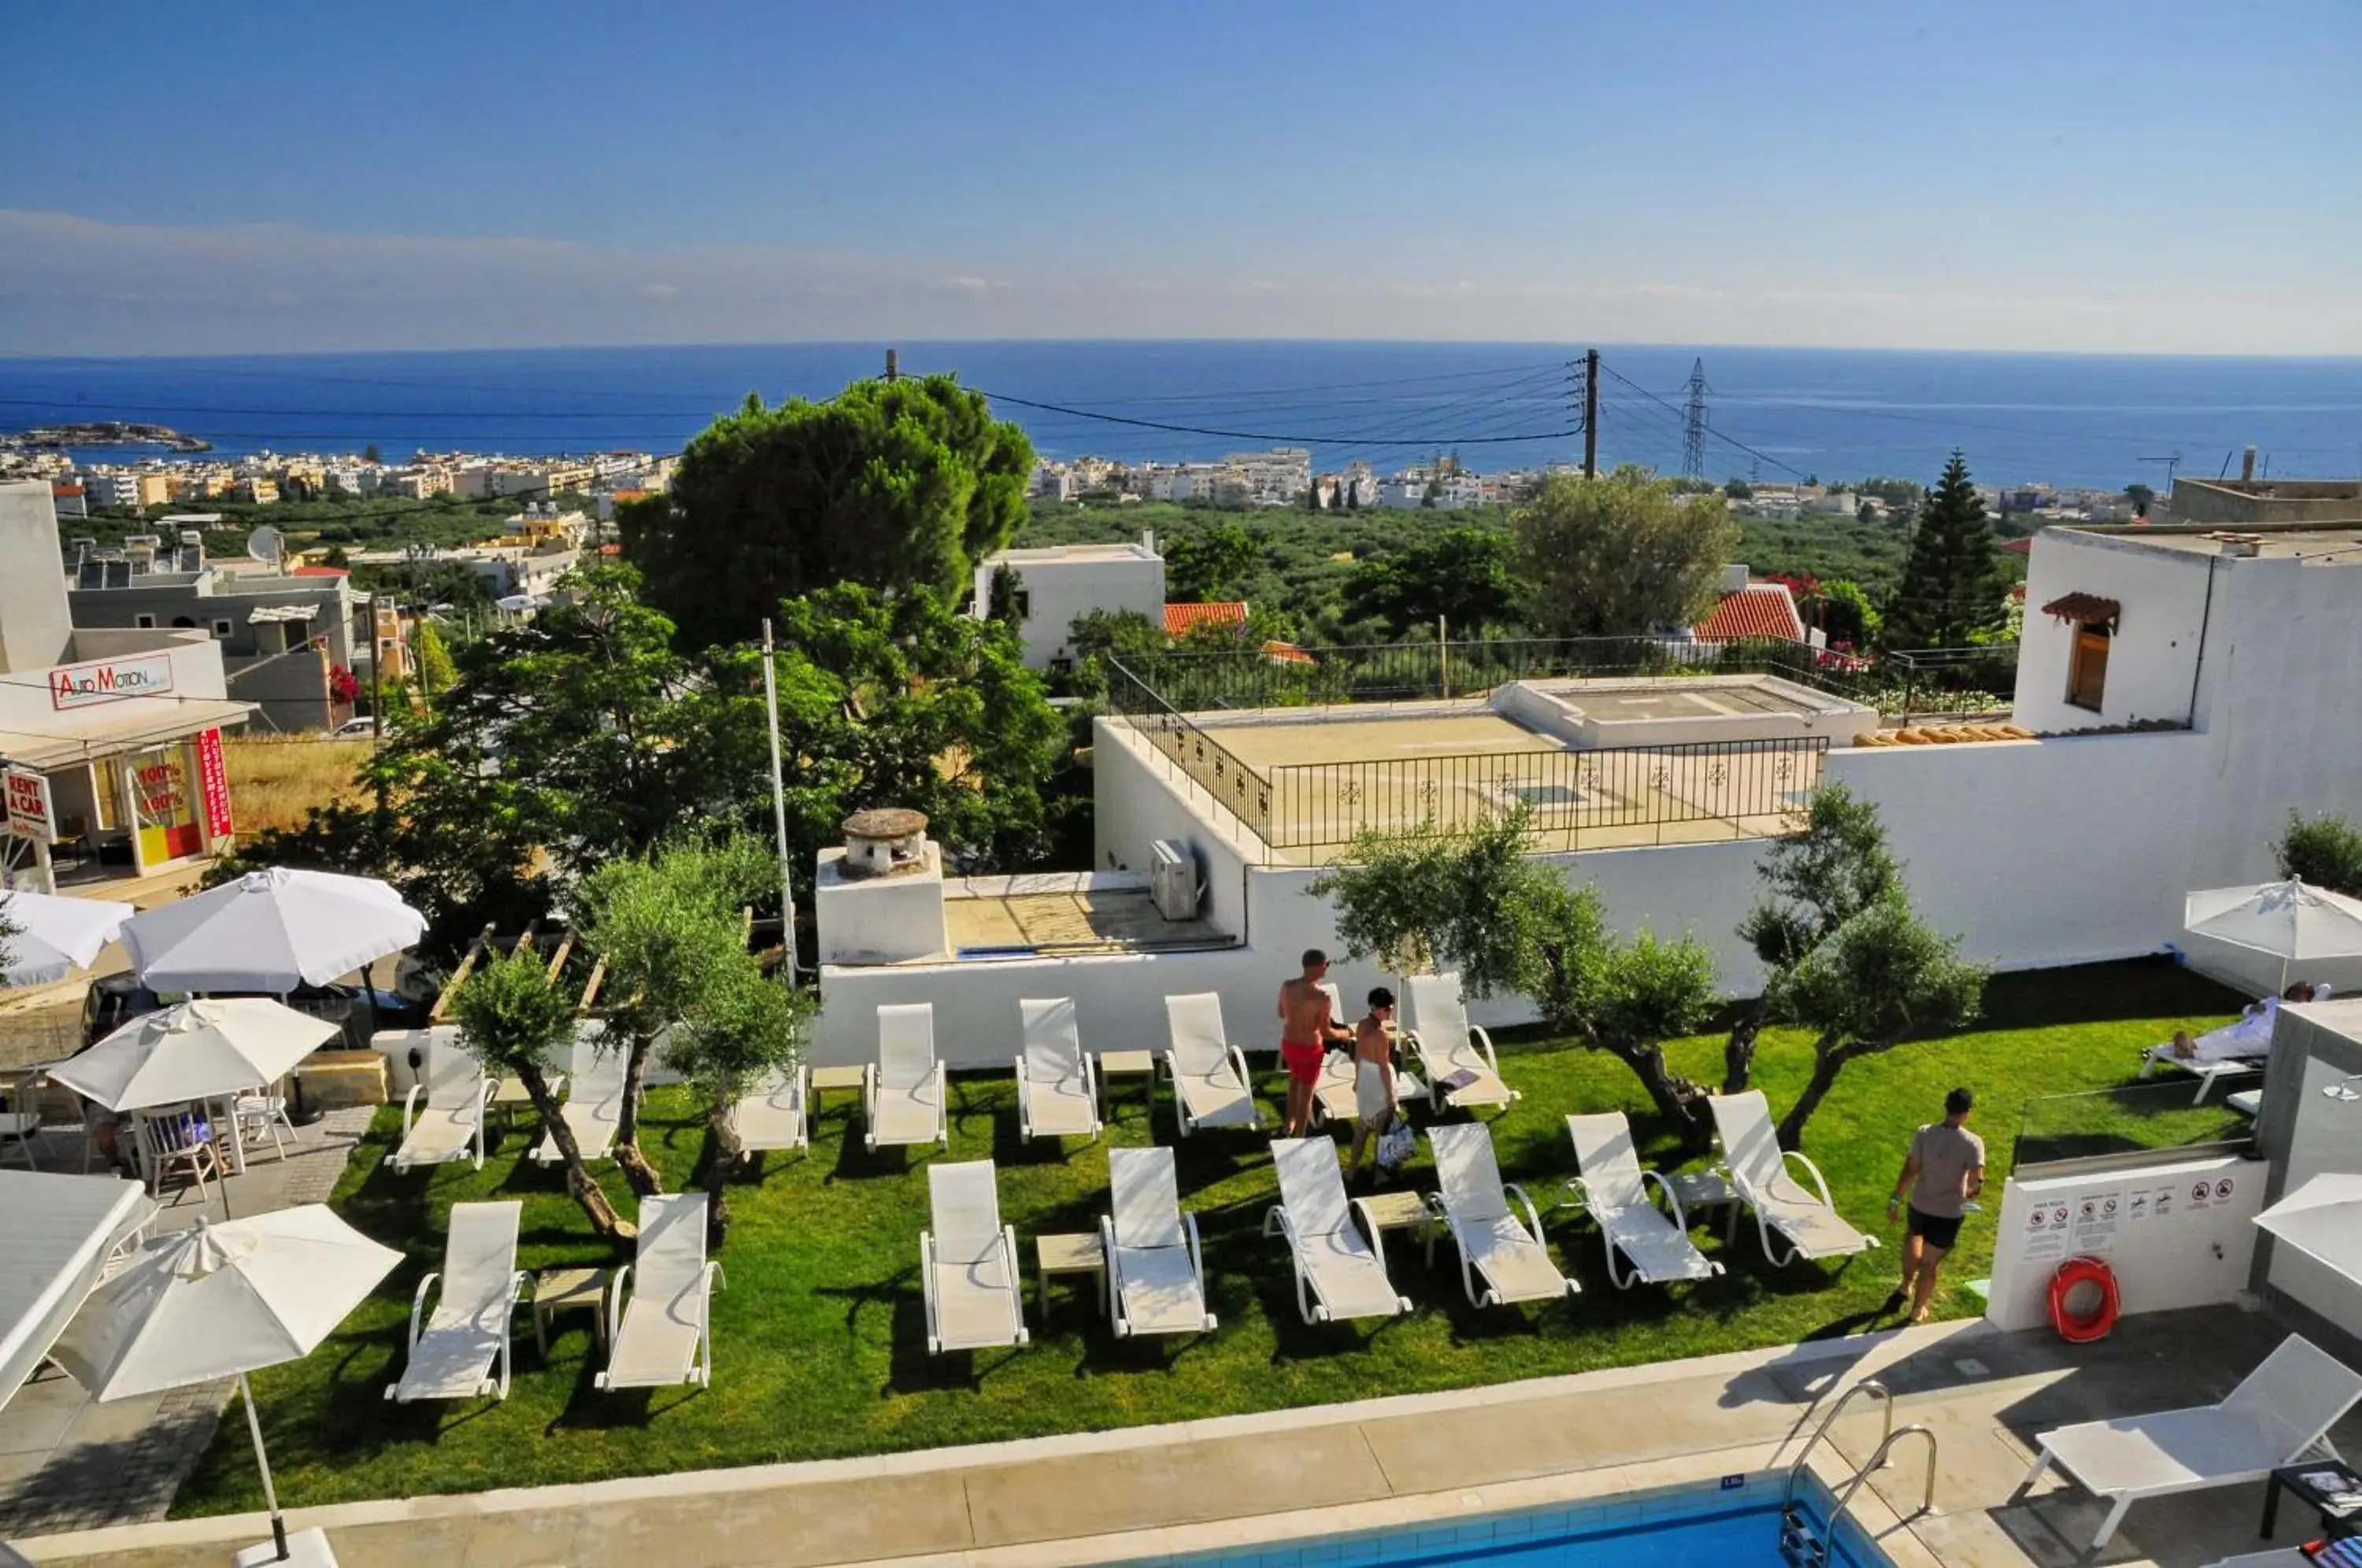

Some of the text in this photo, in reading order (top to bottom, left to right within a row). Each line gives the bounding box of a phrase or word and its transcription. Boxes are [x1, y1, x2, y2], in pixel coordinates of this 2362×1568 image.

[9, 775, 38, 797] RENT
[10, 793, 45, 817] A CAR
